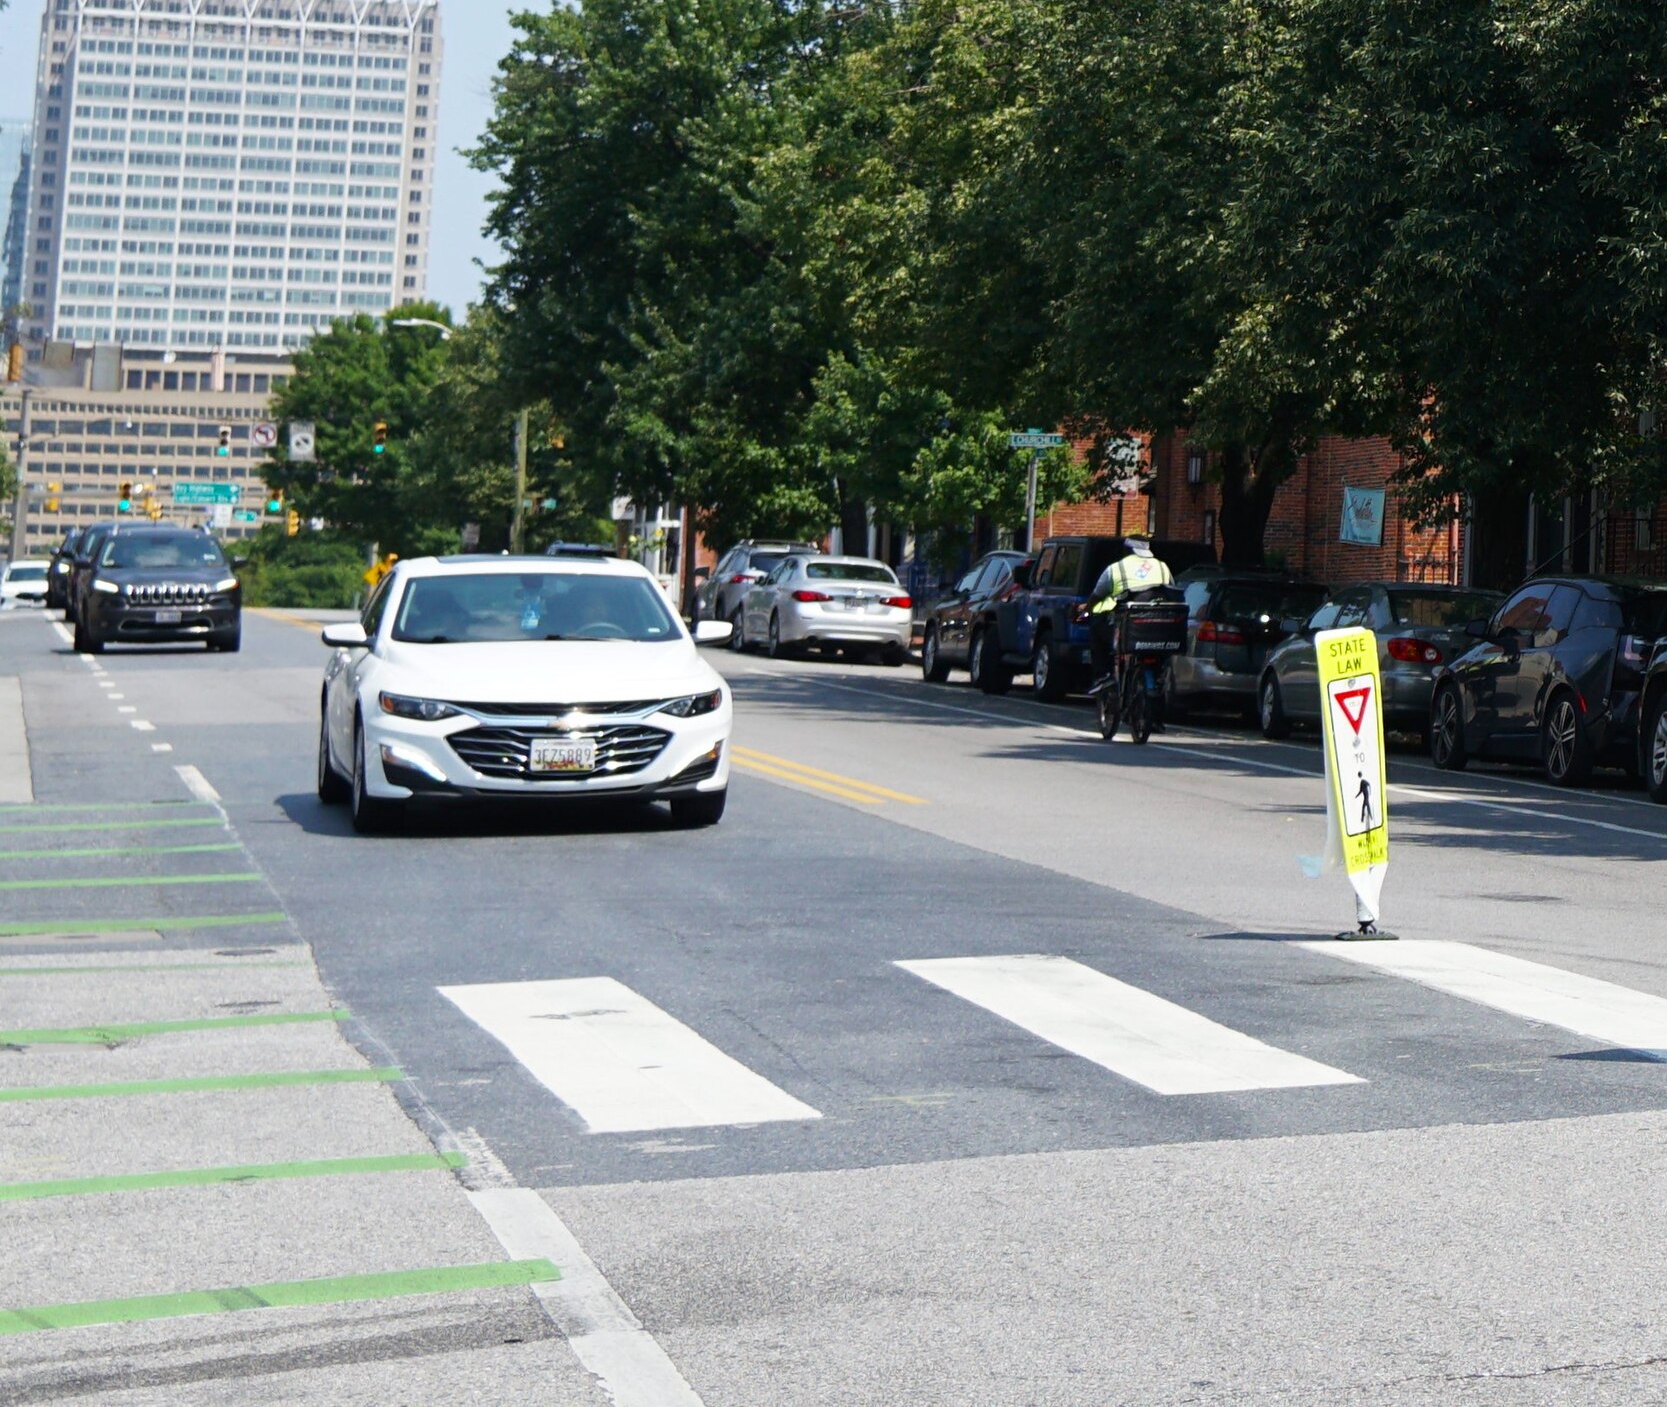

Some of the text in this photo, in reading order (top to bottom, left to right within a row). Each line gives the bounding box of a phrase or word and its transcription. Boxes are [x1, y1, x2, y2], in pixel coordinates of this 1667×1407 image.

[1329, 638, 1366, 657] STATE
[1337, 657, 1362, 674] LAW
[1354, 752, 1365, 763] TO
